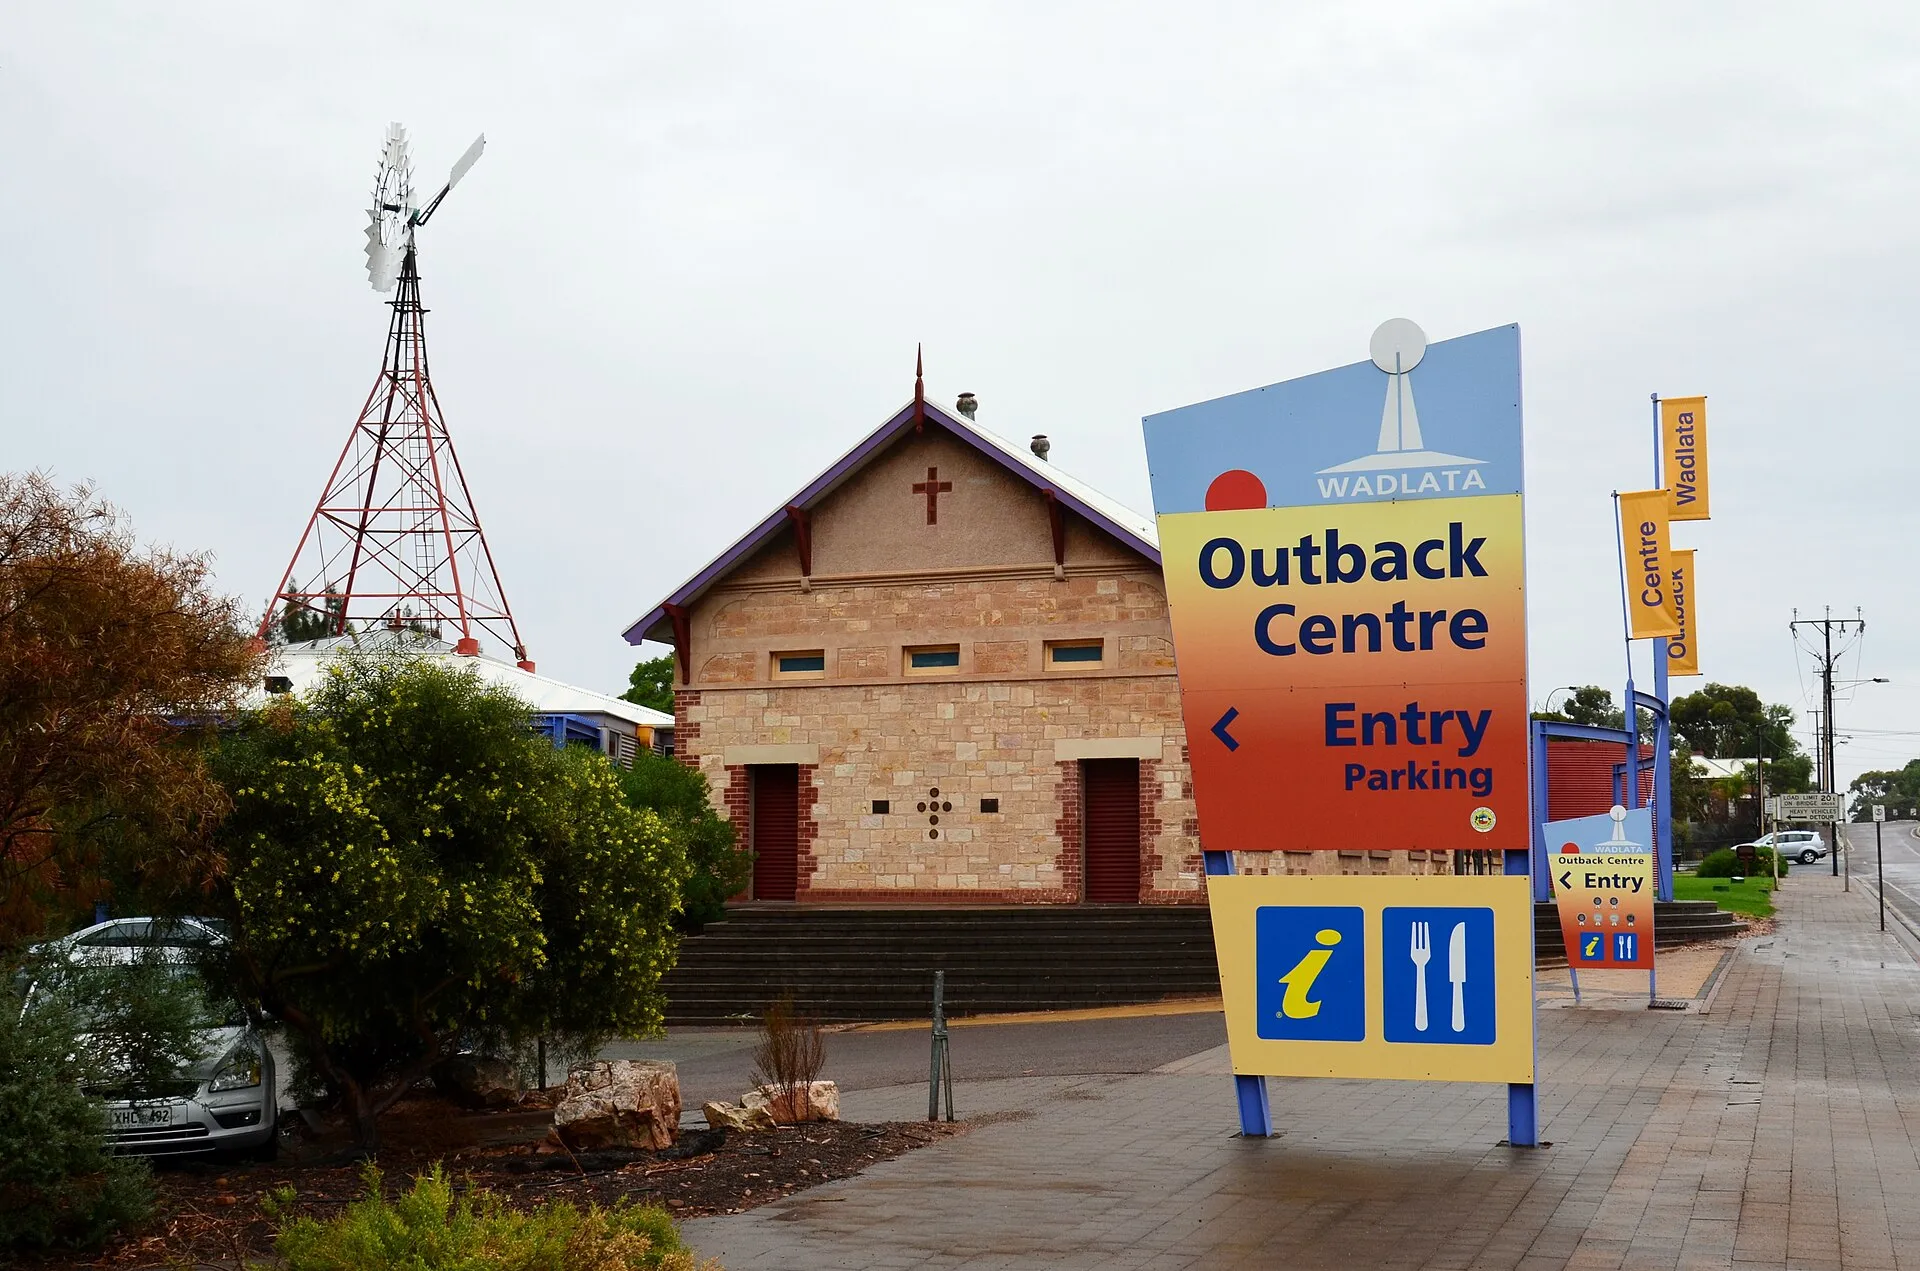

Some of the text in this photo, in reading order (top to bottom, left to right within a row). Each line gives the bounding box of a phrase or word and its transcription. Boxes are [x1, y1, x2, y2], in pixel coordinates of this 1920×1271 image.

[1675, 411, 1696, 506] Wadlata
[1317, 469, 1486, 498] WADLATA
[1199, 521, 1490, 590] Outback
[1639, 520, 1664, 608] Centre
[1253, 599, 1490, 657] Centre
[1324, 700, 1493, 756] Entry
[1344, 760, 1494, 797] Parking
[1820, 794, 1832, 802] 20
[1558, 856, 1645, 865] Outback Centre
[1584, 872, 1644, 893] Entry
